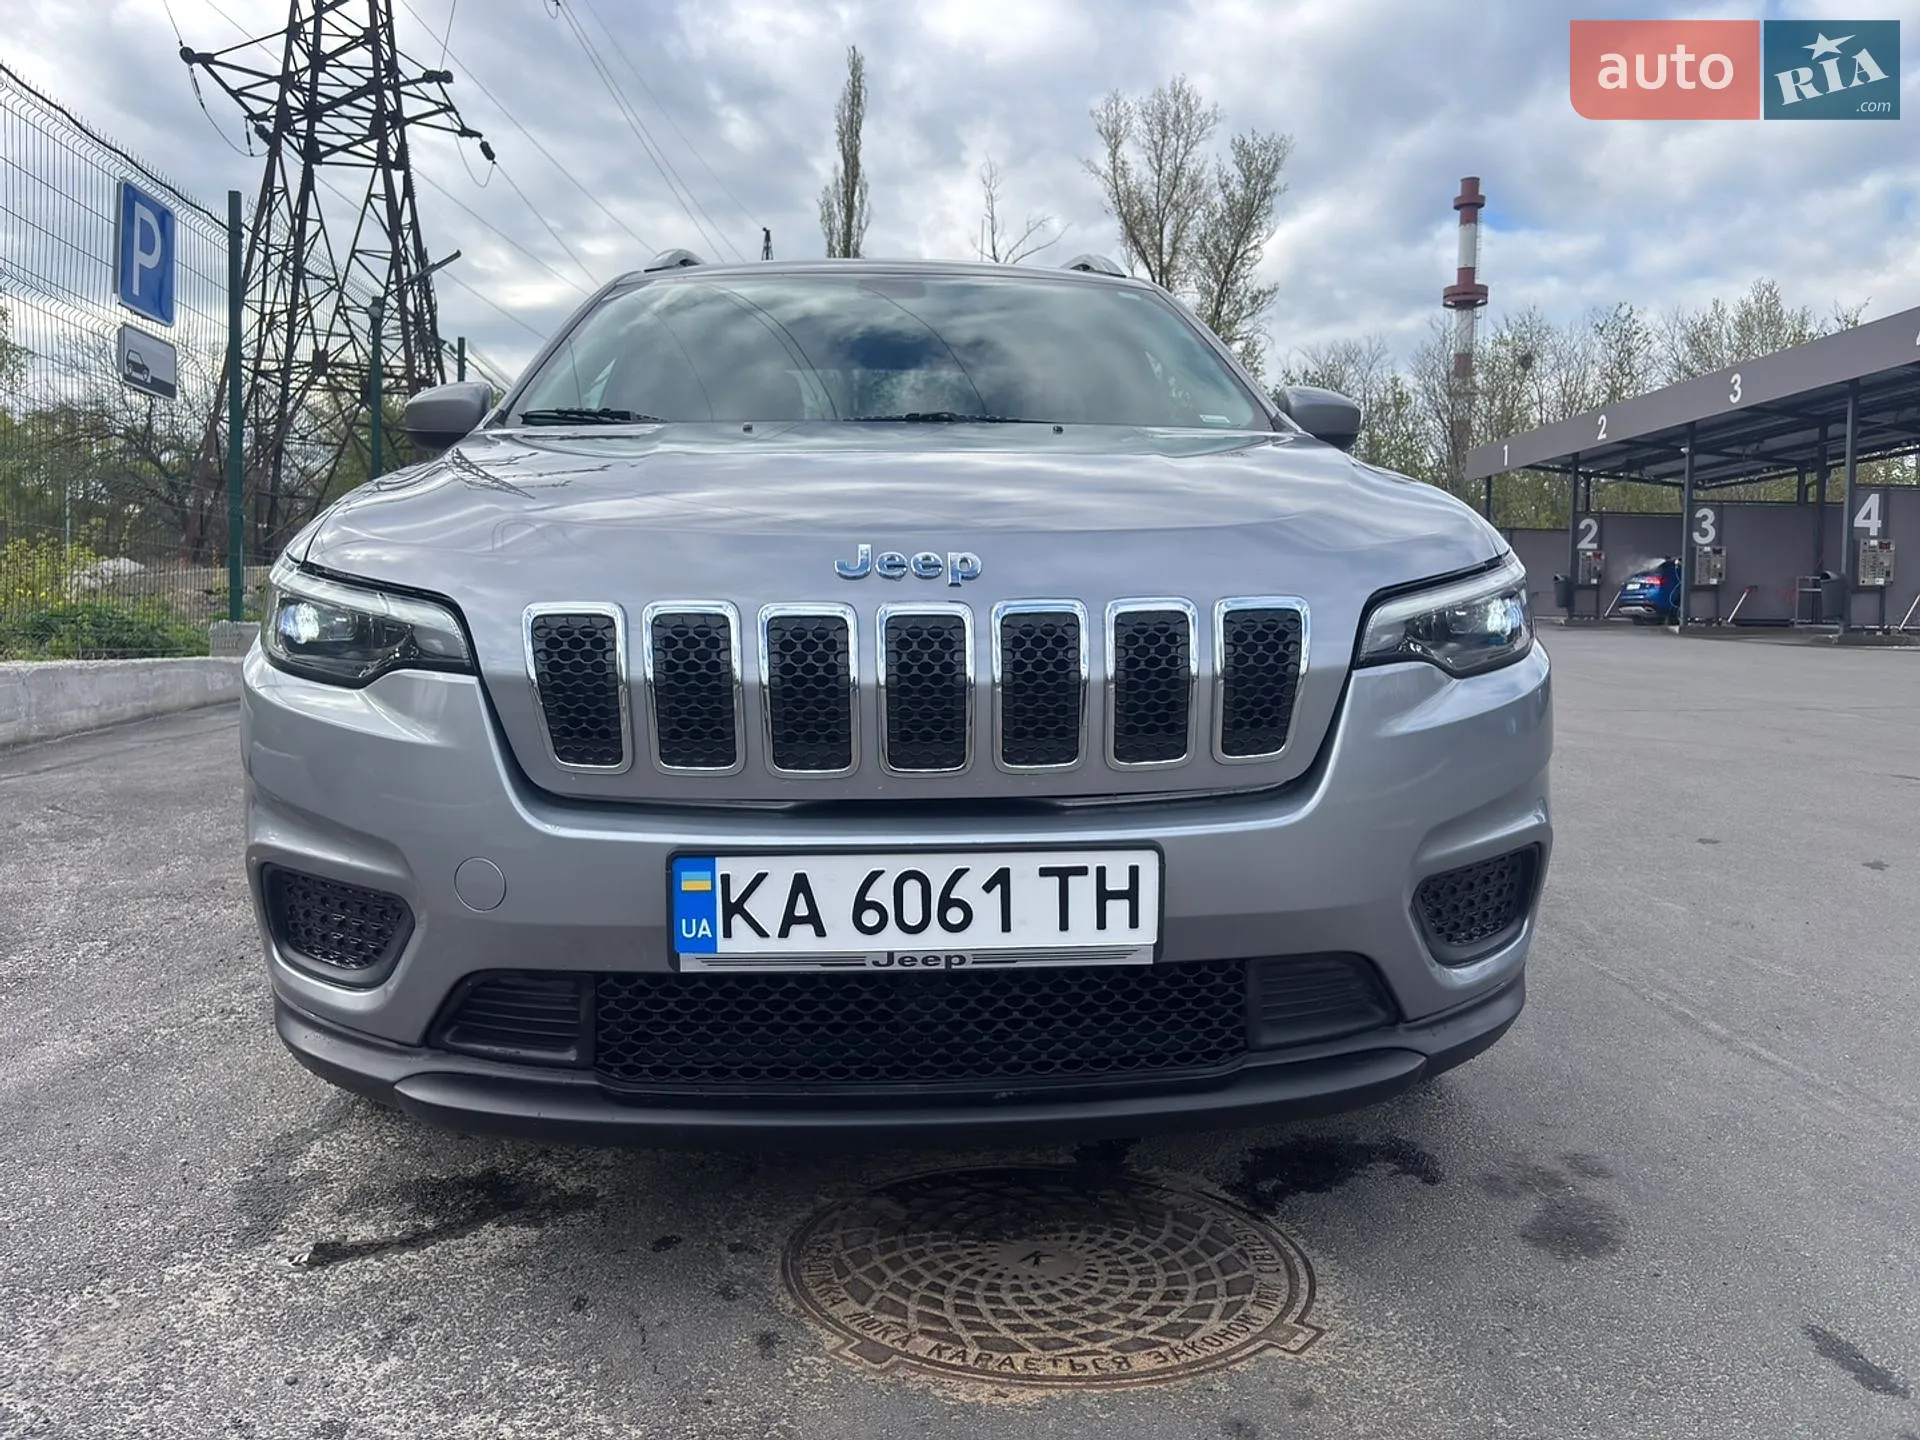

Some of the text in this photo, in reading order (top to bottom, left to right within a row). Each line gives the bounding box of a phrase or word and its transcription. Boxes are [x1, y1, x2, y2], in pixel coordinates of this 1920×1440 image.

[132, 200, 162, 296] P
[1729, 373, 1743, 403] 3
[1597, 415, 1607, 440] 2
[1503, 445, 1509, 466] 1
[1692, 507, 1716, 545] 3
[1853, 493, 1882, 536] 4
[1576, 518, 1598, 549] 2
[834, 543, 982, 587] Jeep
[720, 863, 1140, 938] KA 6061 TH
[681, 918, 712, 938] UA
[871, 951, 967, 970] Jeep
[844, 1312, 913, 1348] ЛЮКА
